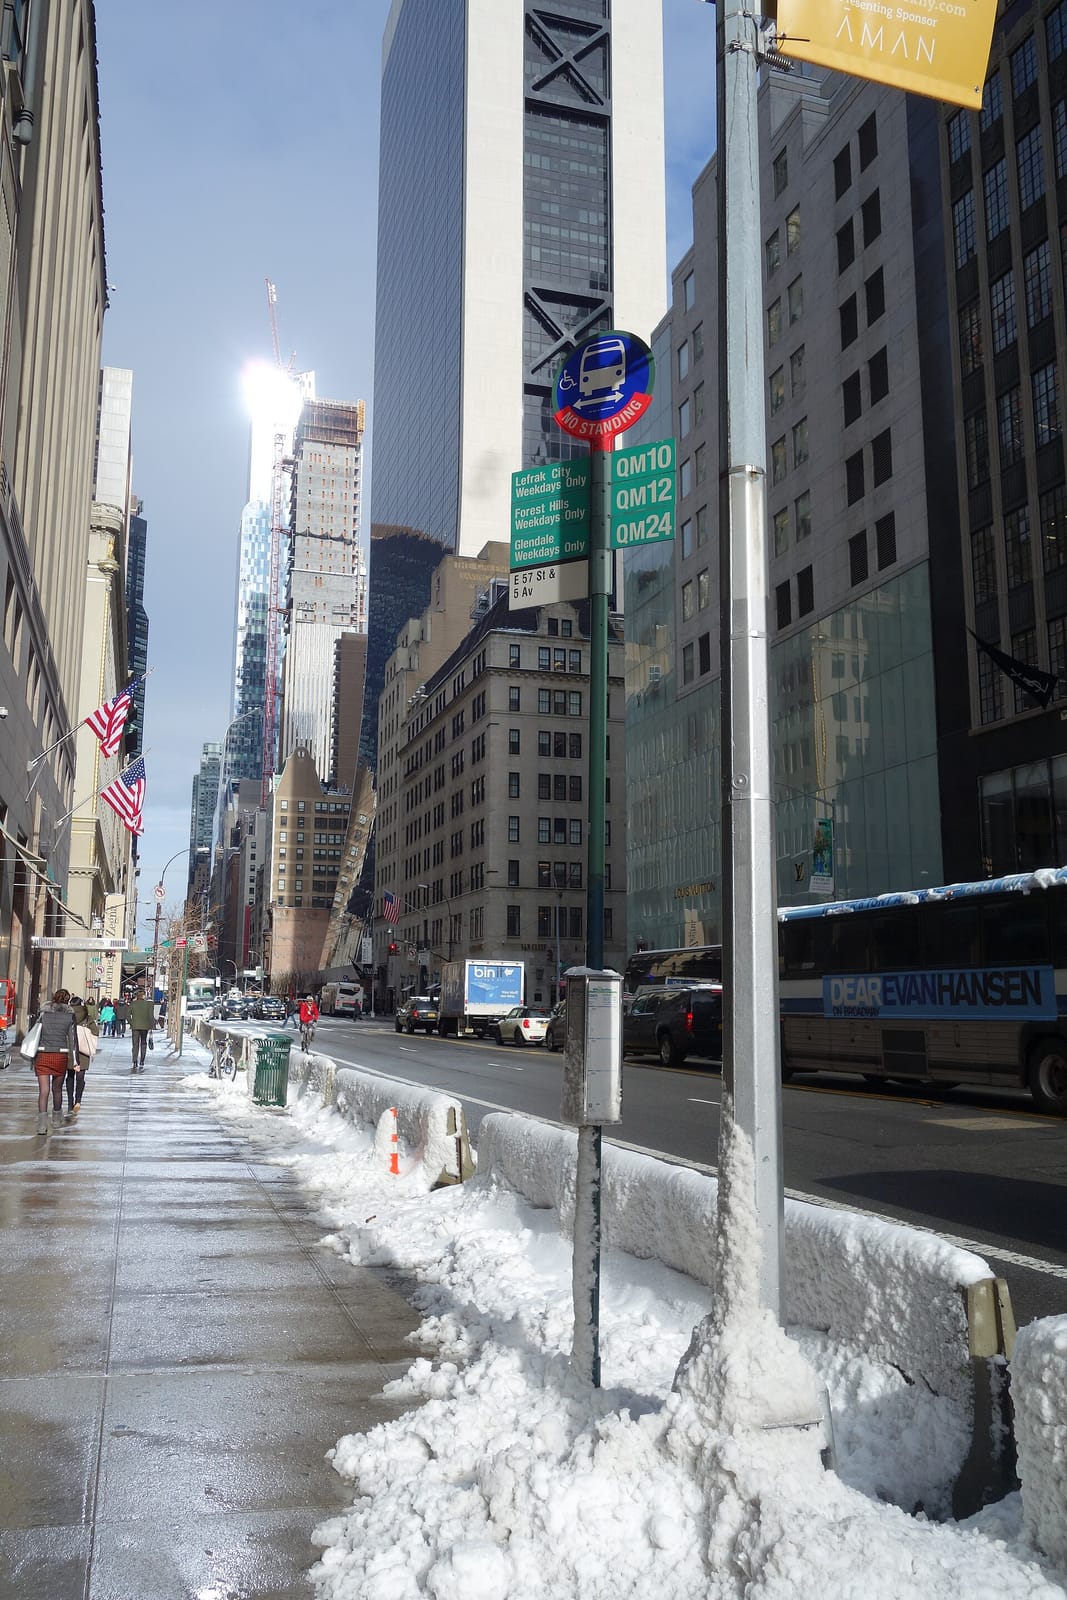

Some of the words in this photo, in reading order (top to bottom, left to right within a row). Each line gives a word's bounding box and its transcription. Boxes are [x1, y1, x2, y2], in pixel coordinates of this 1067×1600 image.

[896, 8, 939, 27] Sponsor
[561, 412, 579, 429] NO
[580, 400, 643, 435] STANDING
[616, 444, 672, 477] QM10
[515, 472, 546, 487] Lefrak
[552, 467, 571, 479] City
[515, 480, 561, 498] Weekdays
[566, 475, 586, 488] Only
[616, 478, 672, 510] QM12
[515, 503, 545, 518] Forest
[549, 499, 569, 512] Hills
[515, 512, 560, 530] Weekdays
[565, 508, 585, 521] Only
[616, 511, 672, 544] QM24
[514, 534, 554, 550] Glendale
[514, 545, 560, 562] Weekdays
[564, 540, 585, 553] Only
[514, 574, 519, 585] E
[522, 572, 533, 584] 57
[536, 570, 546, 581] St
[549, 568, 556, 579] &
[513, 588, 519, 599] 5
[522, 586, 533, 597] Av
[830, 976, 880, 1007] DEAR
[881, 973, 937, 1006] EVAN
[937, 970, 1042, 1007] HANSEN
[832, 1006, 843, 1017] ON
[844, 1005, 880, 1017] BROADWAY
